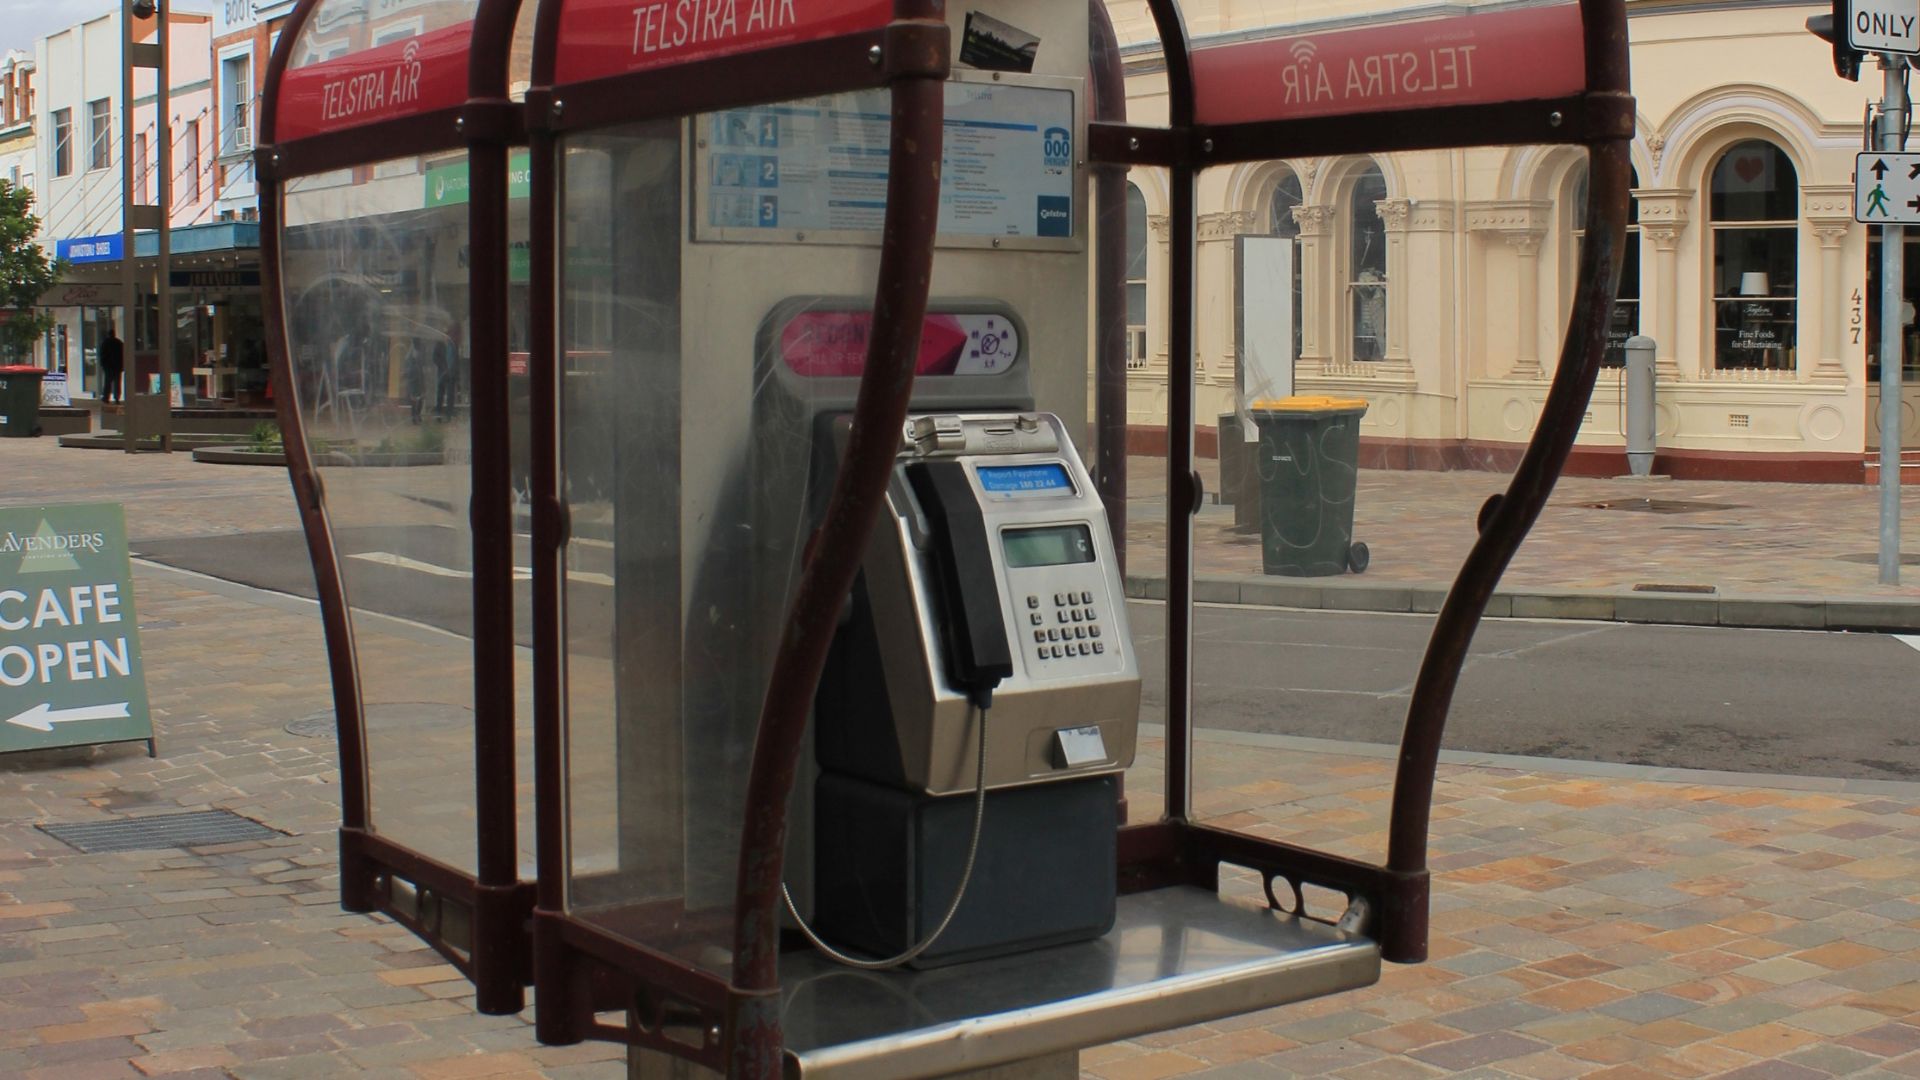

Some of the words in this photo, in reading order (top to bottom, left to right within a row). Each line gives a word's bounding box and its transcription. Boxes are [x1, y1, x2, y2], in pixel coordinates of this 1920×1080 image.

[633, 0, 737, 55] TELSTRA
[1857, 11, 1915, 38] ONLY
[322, 70, 385, 120] TELSTRA
[763, 122, 774, 141] 1
[1044, 140, 1071, 158] 000
[763, 162, 775, 181] 2
[762, 202, 774, 221] 3
[1850, 288, 1862, 344] 437
[1732, 341, 1743, 349] for
[1739, 330, 1753, 339] Fine
[1755, 330, 1775, 339] Foods
[0, 583, 122, 631] CAFE
[0, 637, 131, 686] OPEN
